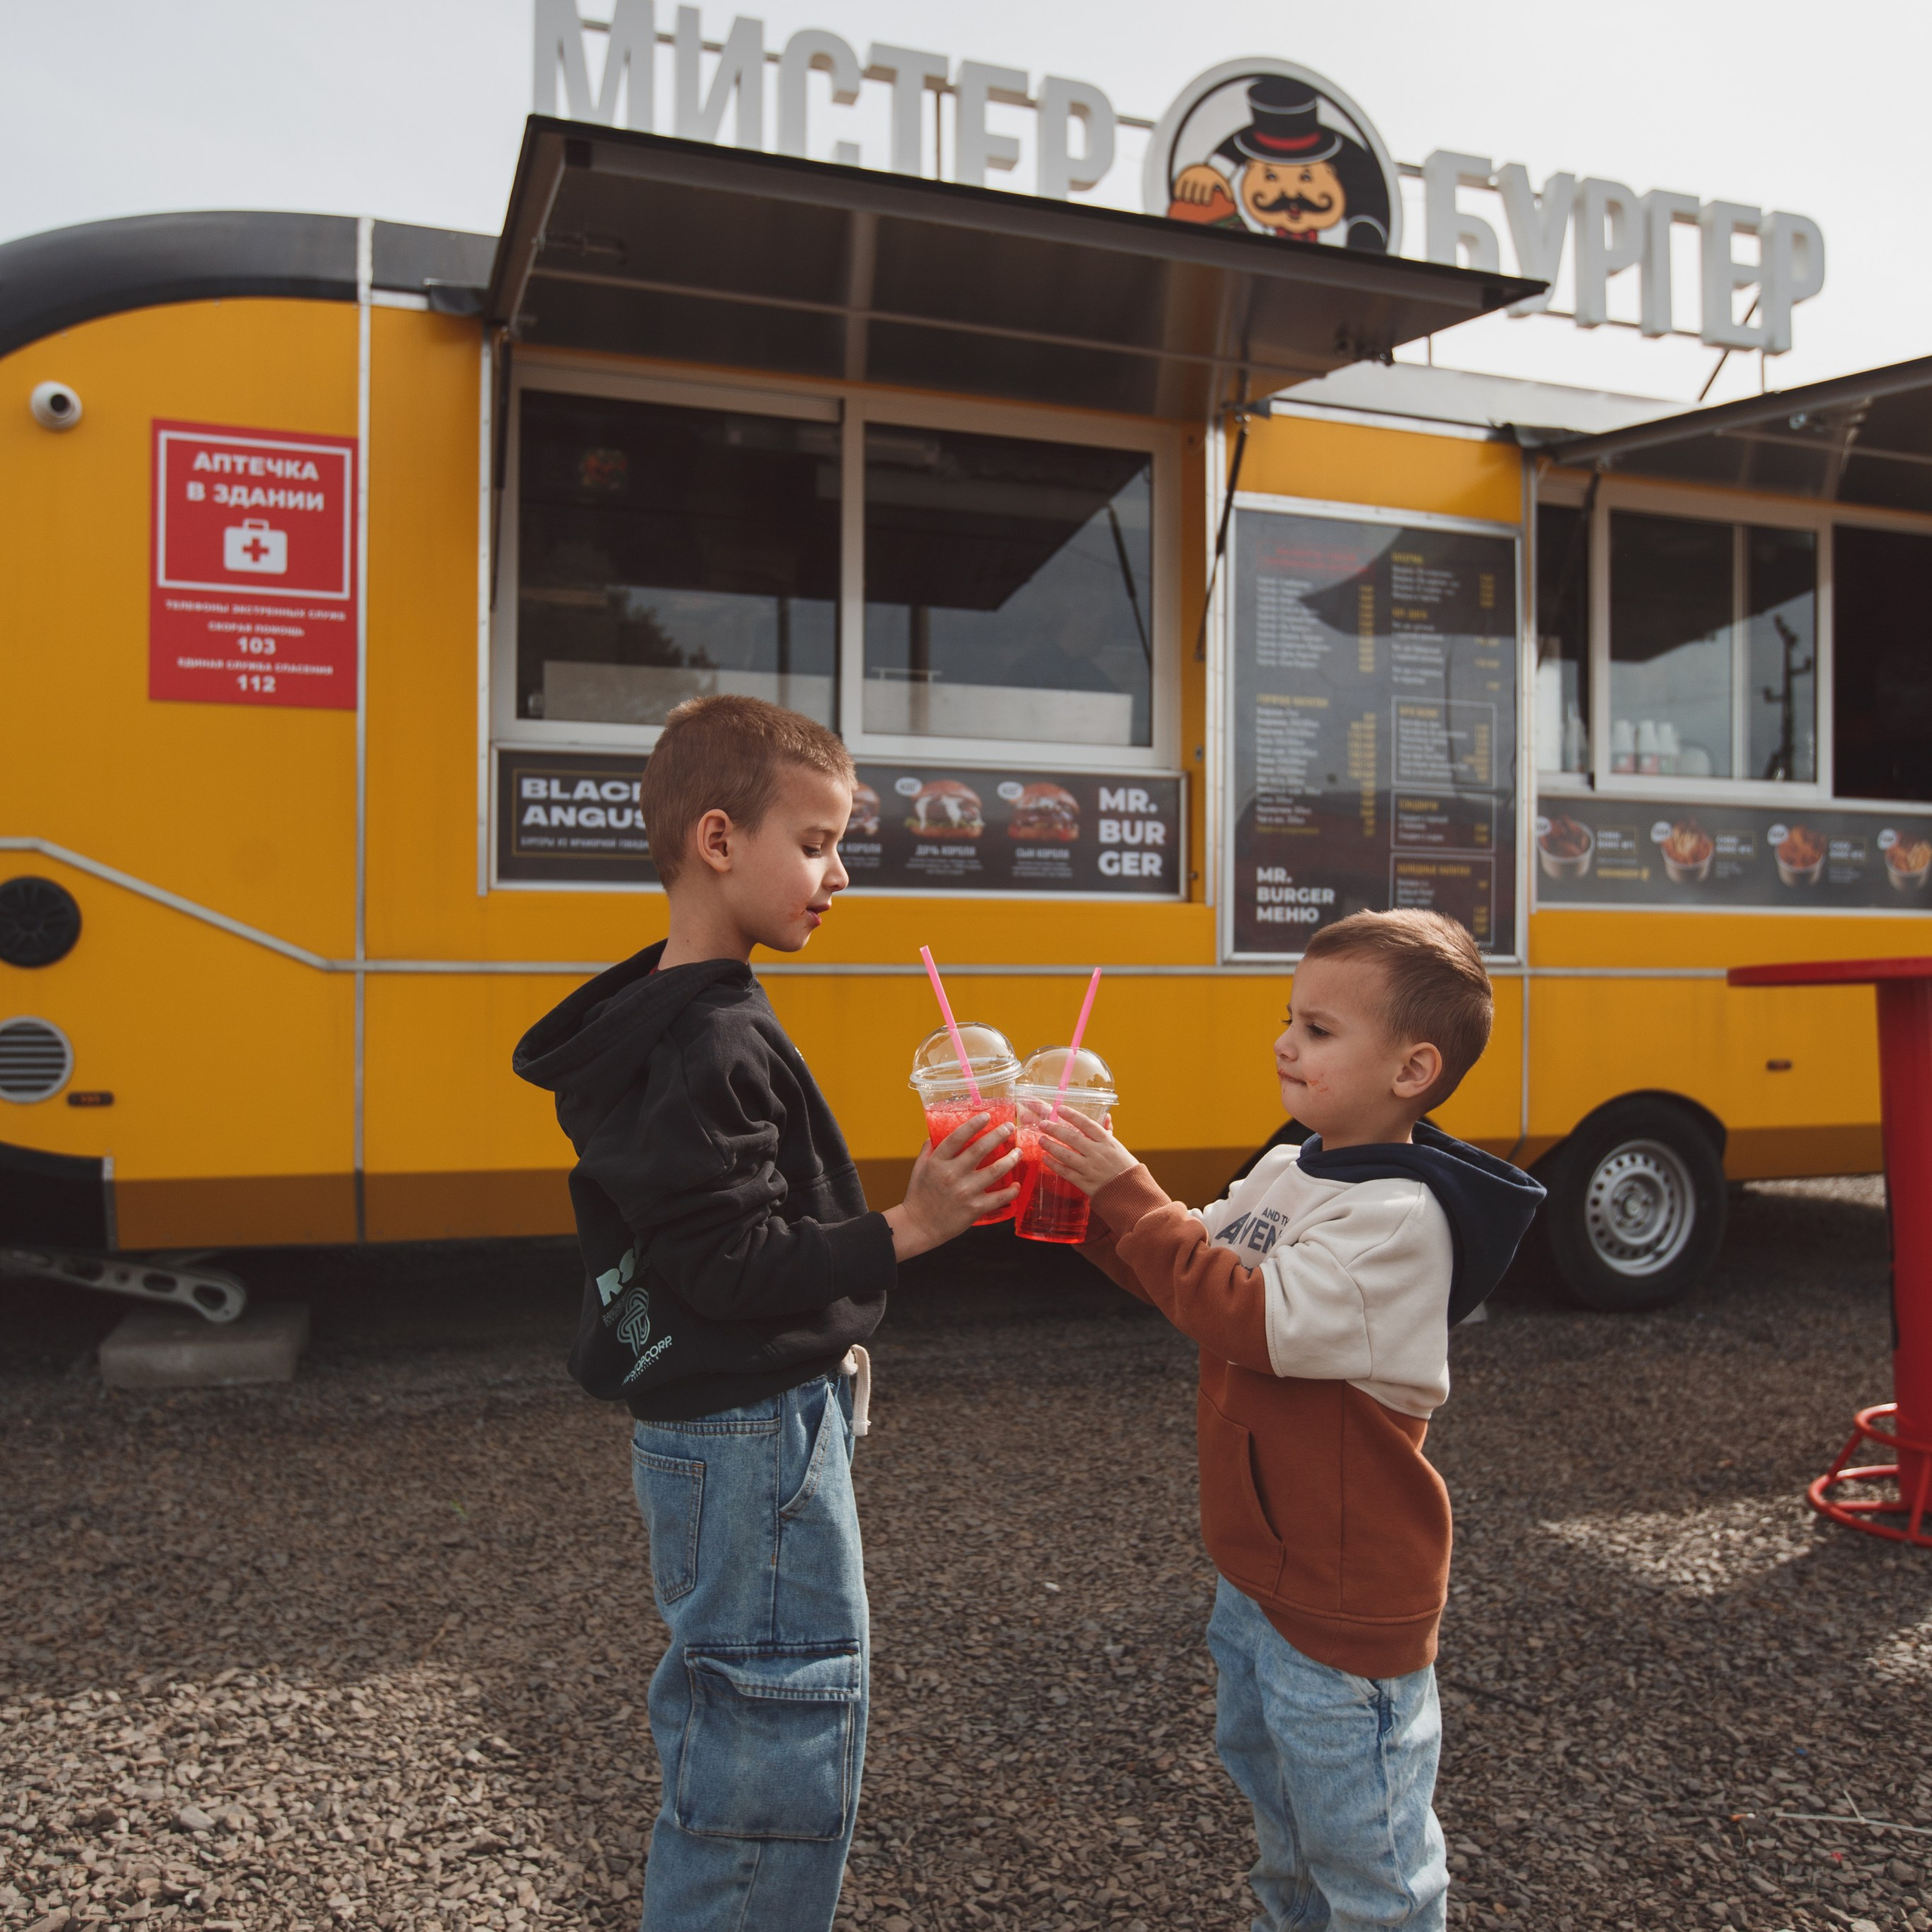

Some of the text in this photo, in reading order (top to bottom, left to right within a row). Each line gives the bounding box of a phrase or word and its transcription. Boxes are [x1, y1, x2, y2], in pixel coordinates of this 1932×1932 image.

[534, 0, 1825, 356] МИСТЕР БУРГЕР
[193, 451, 319, 481] АПТЕЧКА
[186, 481, 325, 511] В ЗДАНИИ
[237, 636, 276, 655] 103
[237, 674, 276, 692] 112
[1098, 787, 1158, 813] MR.
[1098, 819, 1166, 845] BUR
[1098, 851, 1163, 877] GER
[1256, 867, 1293, 884] MR.
[1256, 887, 1336, 904] BURGER
[1256, 906, 1320, 923] МЕНЮ
[1262, 1206, 1280, 1222] AND
